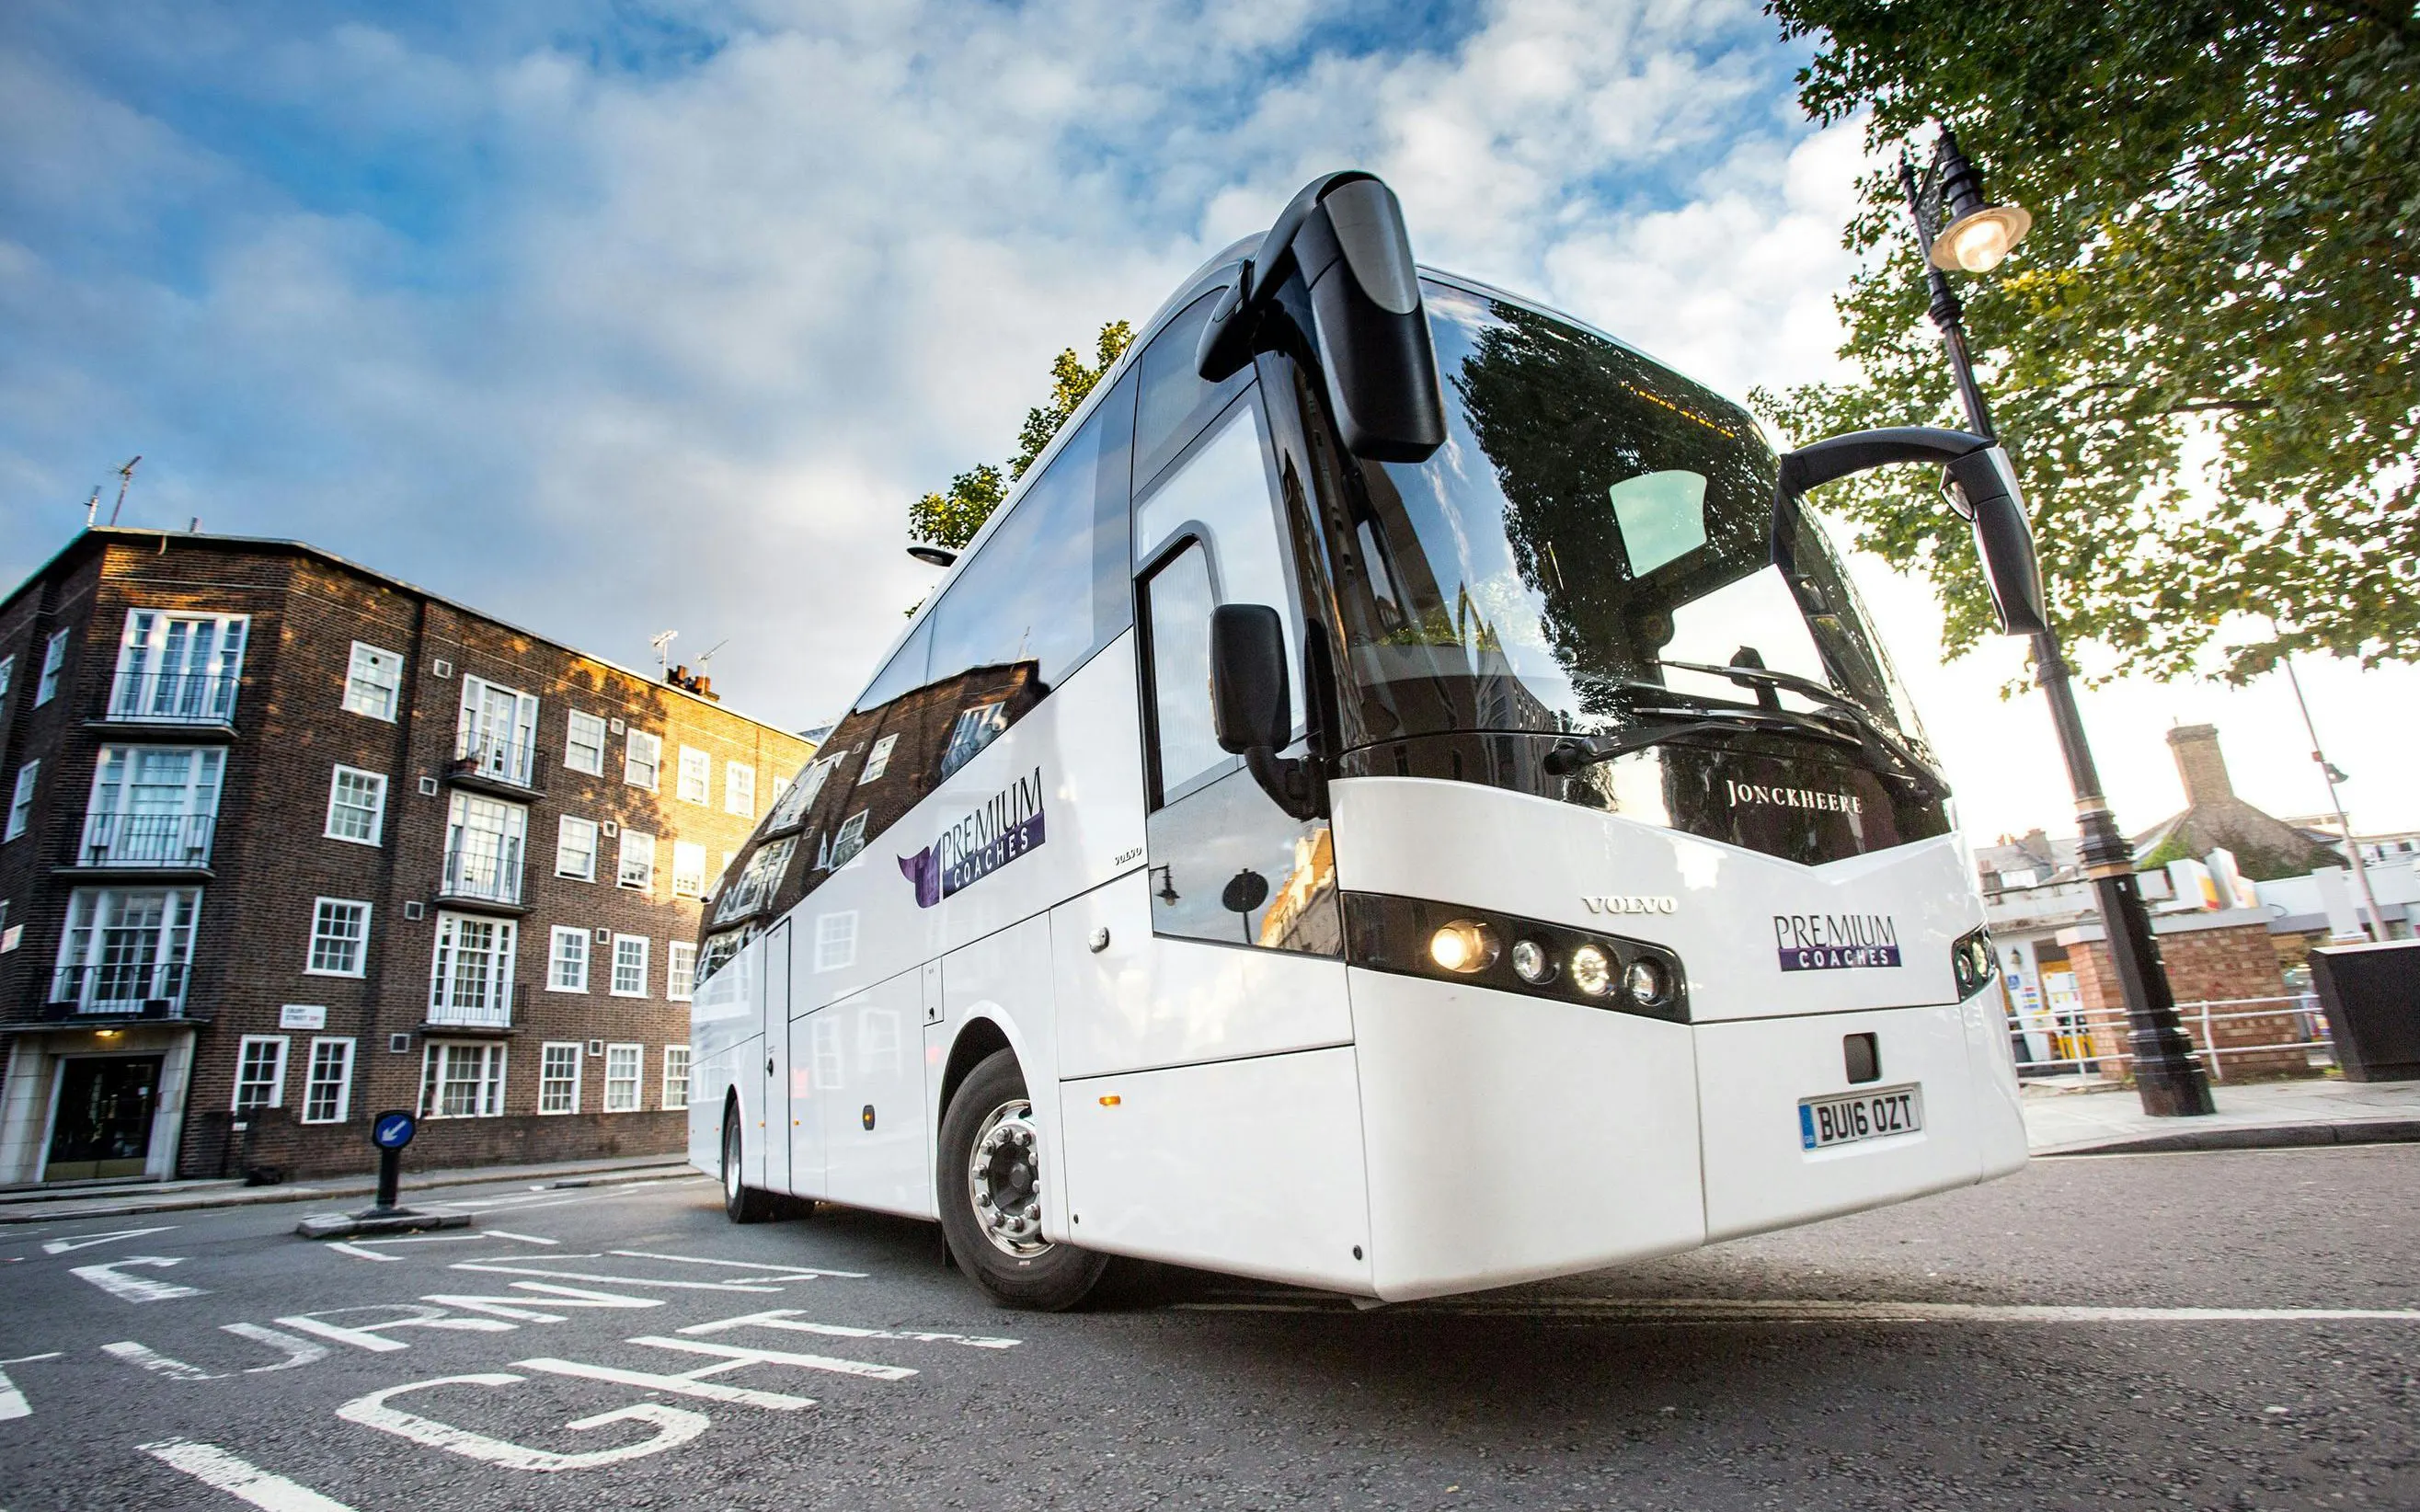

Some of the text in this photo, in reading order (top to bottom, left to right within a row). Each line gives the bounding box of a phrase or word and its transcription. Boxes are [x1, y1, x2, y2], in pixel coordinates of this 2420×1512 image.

[1726, 780, 1863, 816] JONCKHEERE
[942, 765, 1044, 872] PREMIUM
[954, 827, 1028, 888] COACHES
[1581, 896, 1678, 915] VOLVO
[1772, 914, 1898, 948] PREMIUM
[1798, 949, 1889, 968] COACHES
[1818, 1094, 1911, 1141] BU16 OZT
